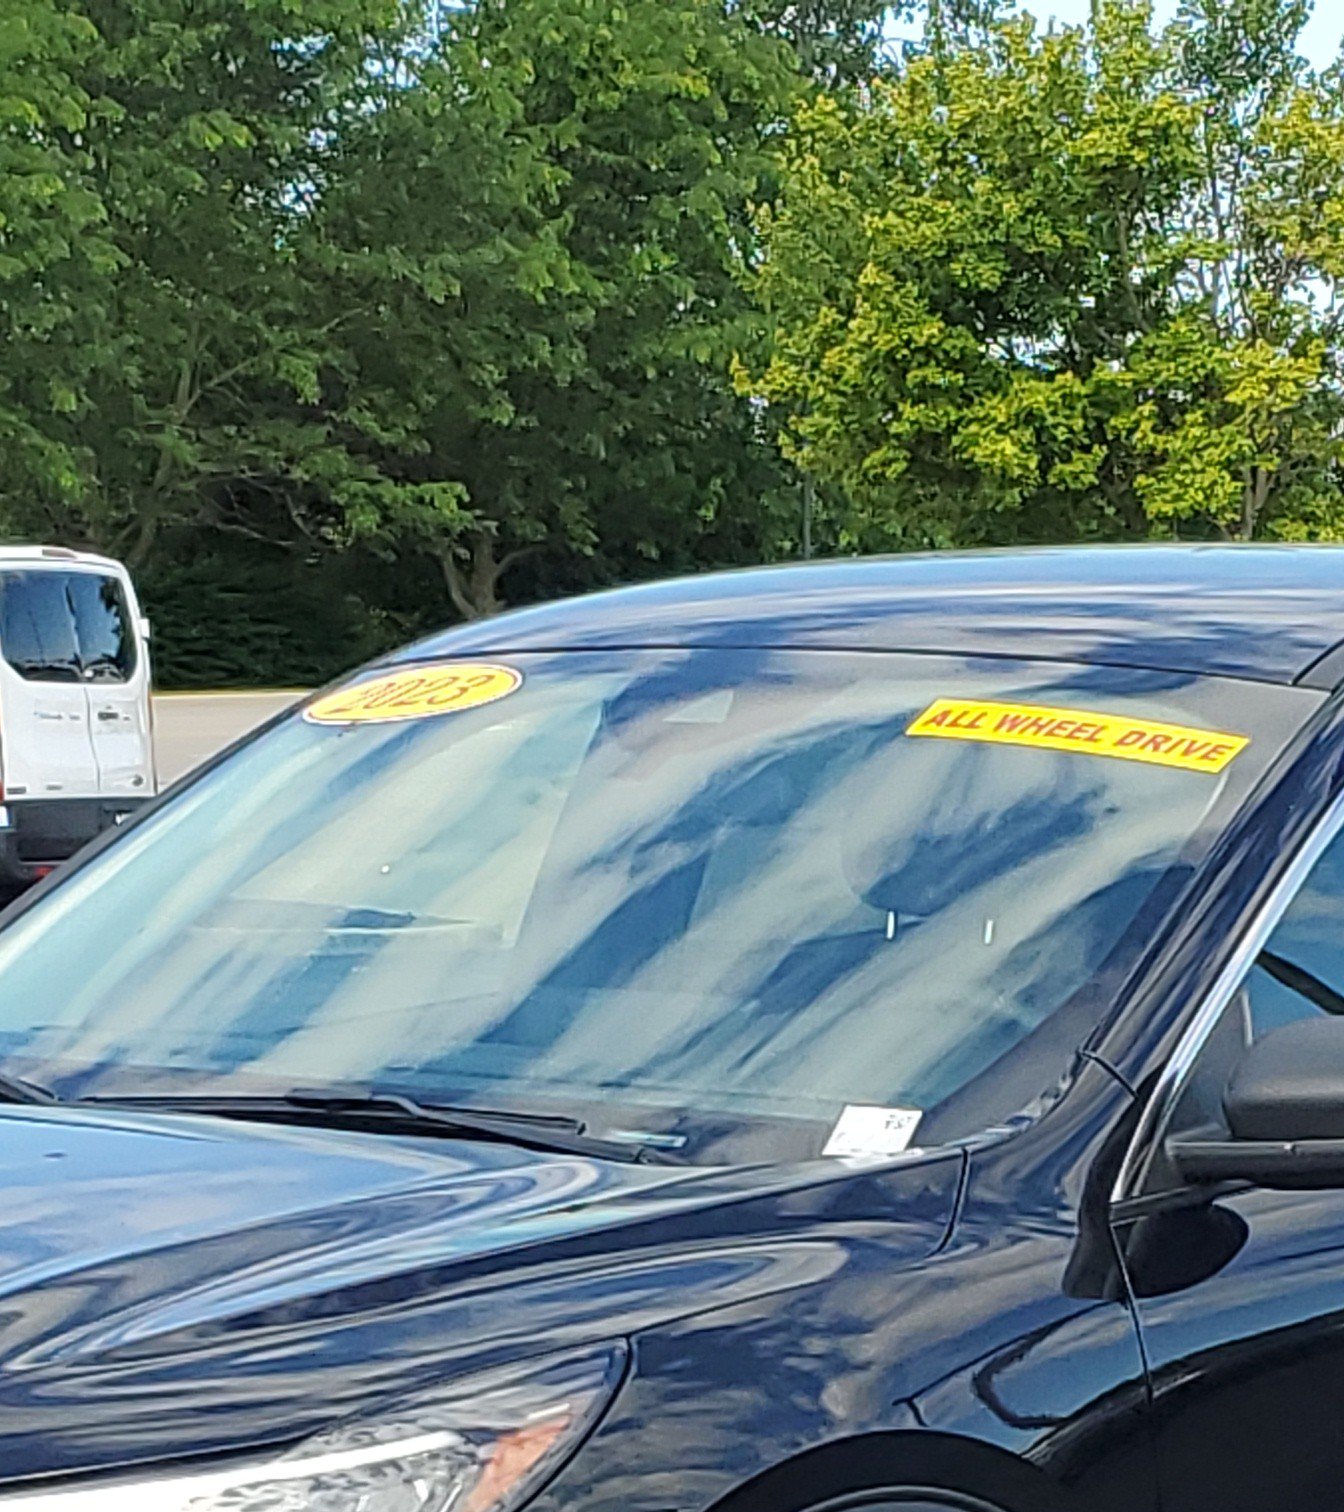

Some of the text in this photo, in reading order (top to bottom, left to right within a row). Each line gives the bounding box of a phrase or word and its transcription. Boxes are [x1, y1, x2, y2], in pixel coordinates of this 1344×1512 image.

[324, 674, 496, 715] 2023
[922, 709, 1235, 763] ALL WHEEL DRIVE
